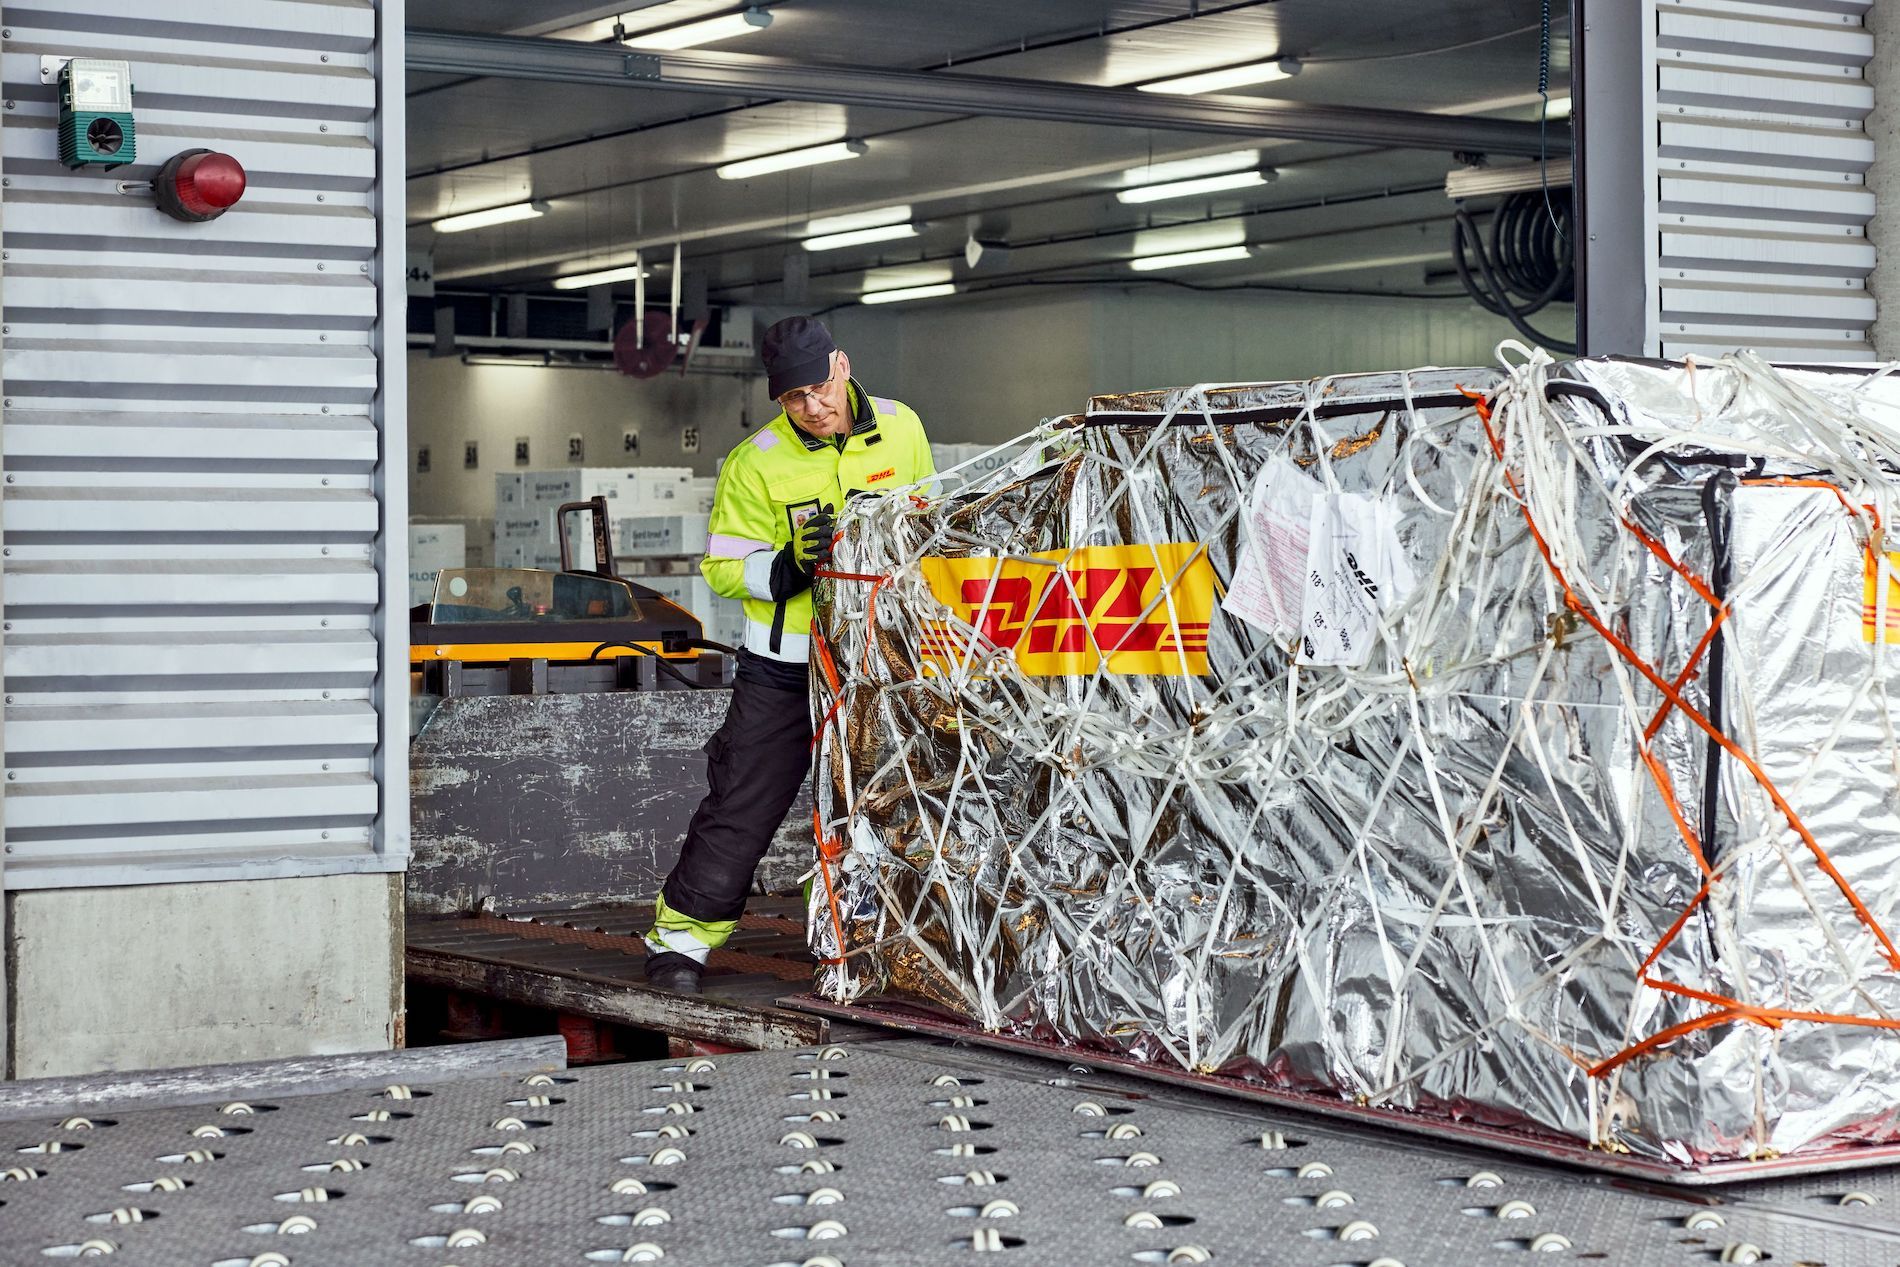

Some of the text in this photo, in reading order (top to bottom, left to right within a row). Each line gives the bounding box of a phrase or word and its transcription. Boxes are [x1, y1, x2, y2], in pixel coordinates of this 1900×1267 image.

[625, 433, 637, 452] 54
[685, 428, 697, 447] 55
[570, 438, 581, 457] 53
[871, 469, 892, 482] DHL
[1346, 552, 1378, 599] DHL
[961, 567, 1168, 653] DHL
